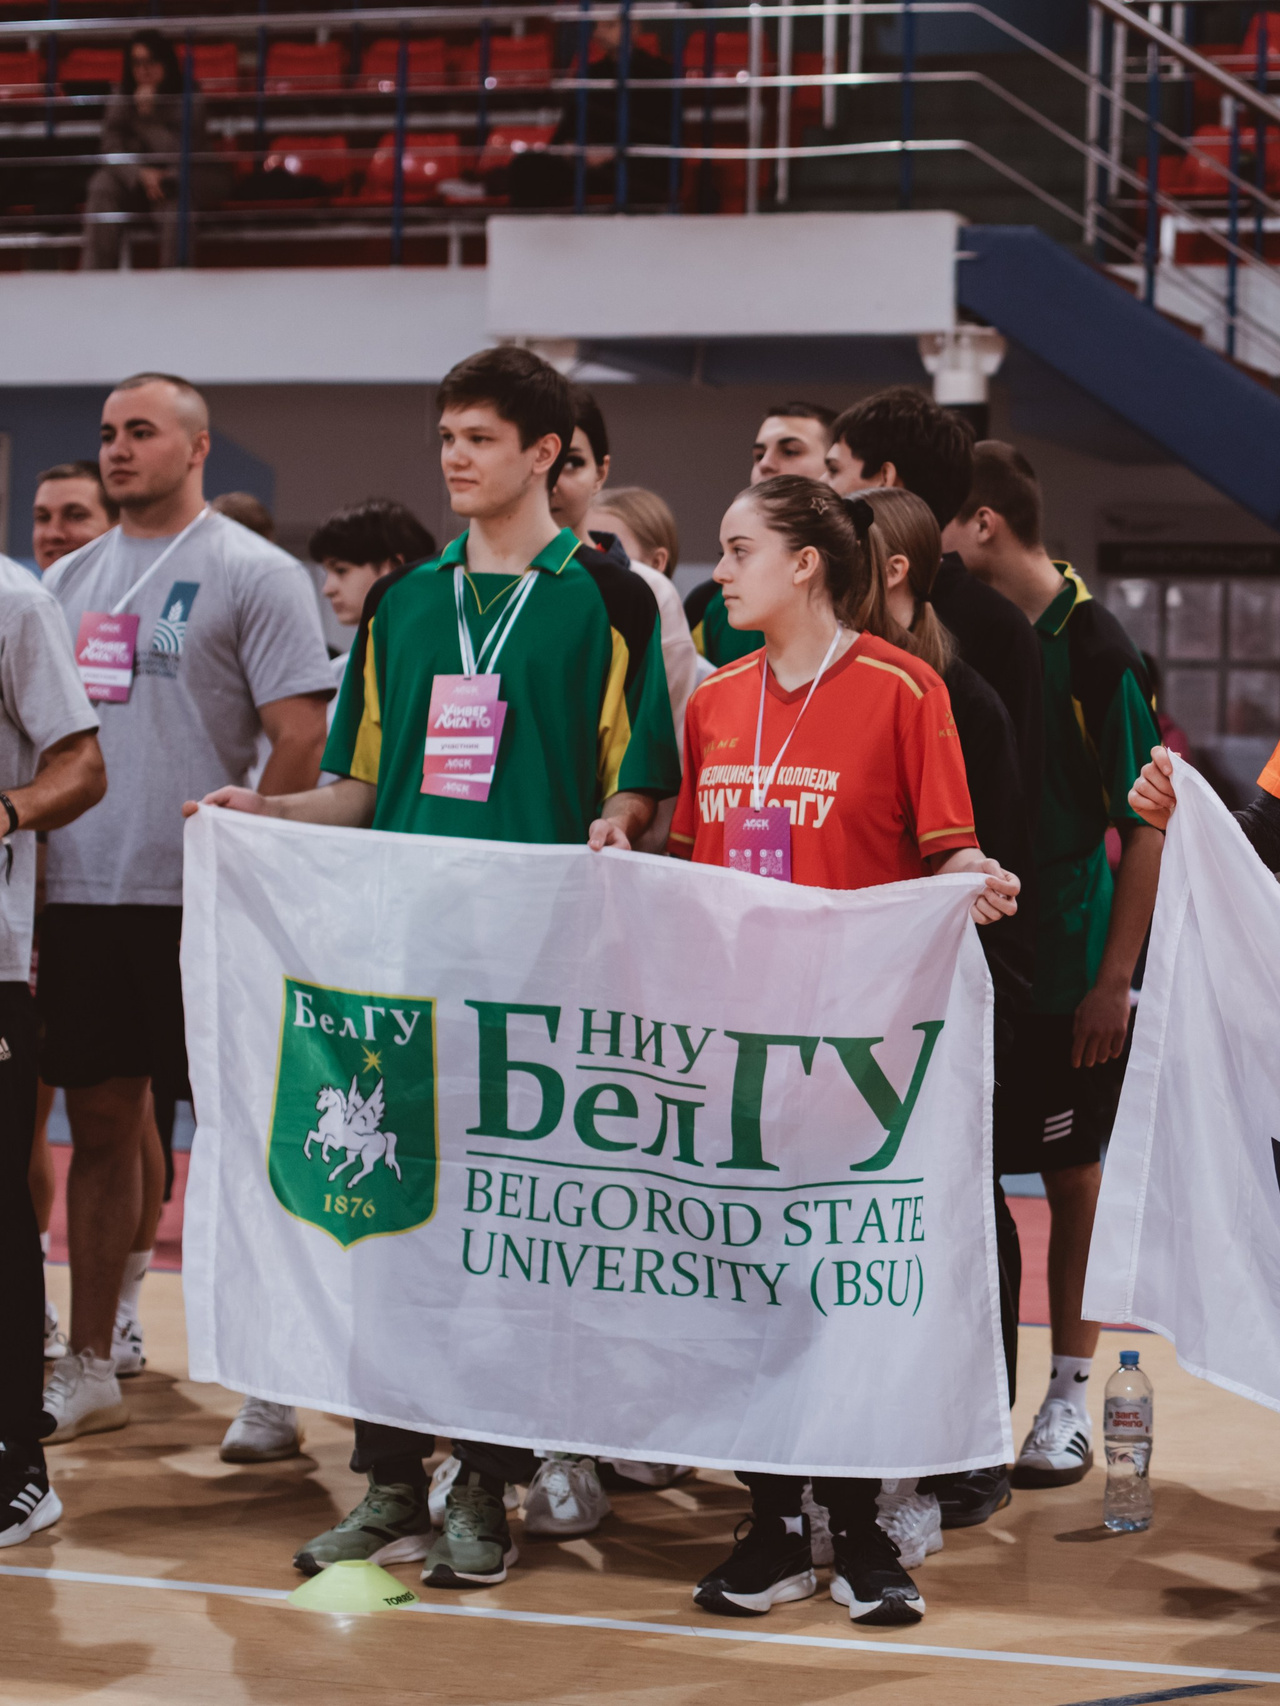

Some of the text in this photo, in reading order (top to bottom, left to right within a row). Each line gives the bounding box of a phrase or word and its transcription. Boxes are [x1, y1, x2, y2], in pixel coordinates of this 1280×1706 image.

[776, 766, 841, 792] КОЛЛЕДЖ
[293, 990, 421, 1046] БелГУ
[576, 1007, 717, 1075] НИУ
[463, 998, 946, 1174] БелГУ
[321, 1192, 377, 1220] 1876
[463, 1166, 927, 1249] BELGOROD STATE
[460, 1227, 926, 1317] UNIVERSITY (BSU)
